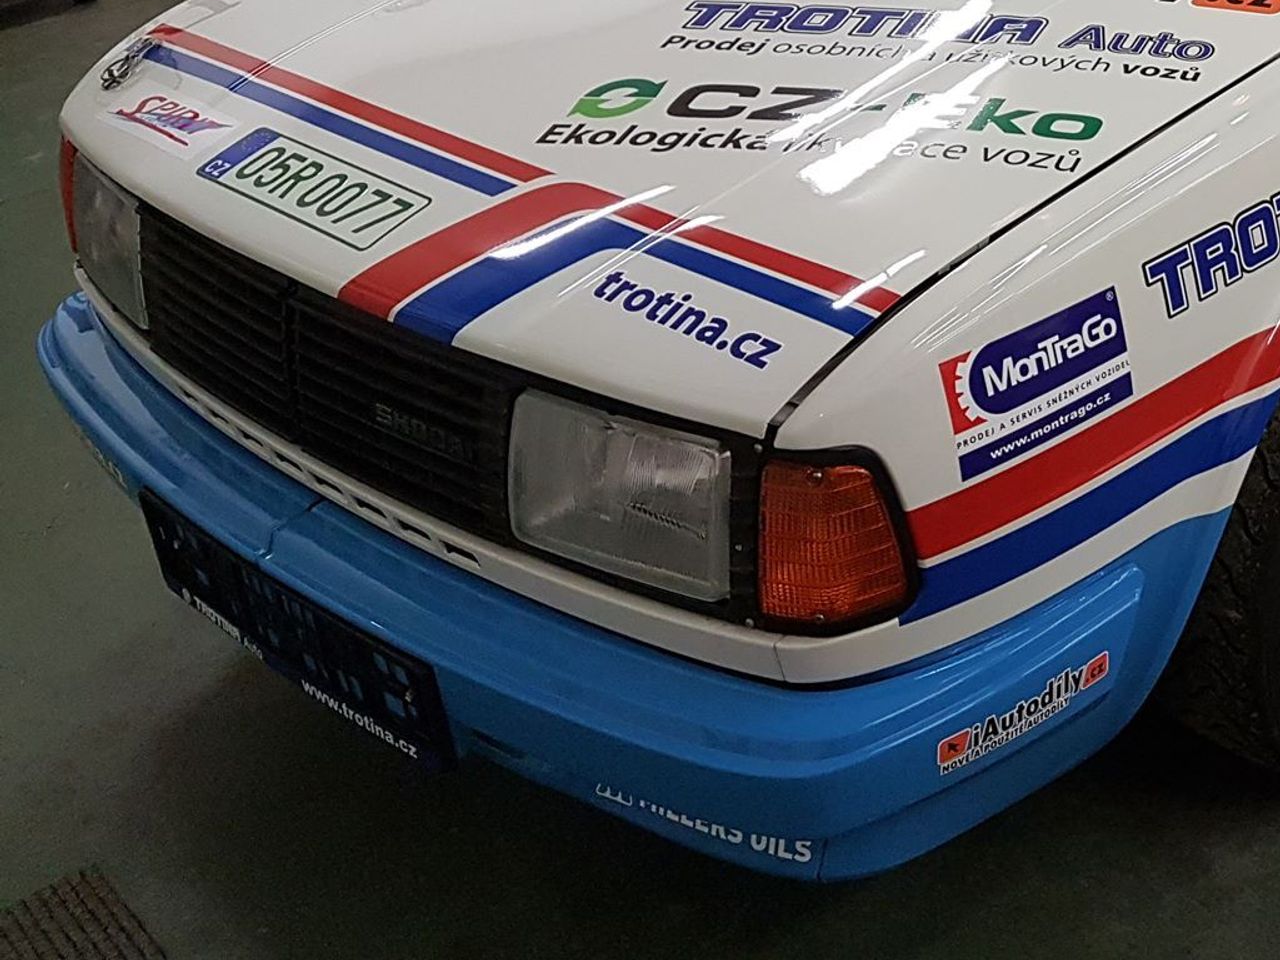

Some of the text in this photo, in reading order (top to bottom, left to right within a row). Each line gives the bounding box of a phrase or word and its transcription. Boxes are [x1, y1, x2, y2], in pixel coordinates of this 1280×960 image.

[660, 35, 770, 55] Prodej
[1121, 65, 1202, 83] vozů
[680, 0, 1216, 63] TROTIA Auto
[666, 83, 1104, 141] CZ-ko
[203, 159, 230, 179] CZ
[536, 123, 768, 153] Ekologická
[981, 148, 1082, 173] vozů
[592, 270, 784, 370] trotina.cz
[981, 313, 1118, 398] MonTraGo
[955, 428, 996, 450] PRODEJ
[999, 422, 1007, 431] A
[1009, 404, 1043, 426] SERVIS
[1095, 360, 1131, 383] VOZIDEL
[989, 392, 1112, 460] www.montrago.cz
[300, 678, 418, 759] www.trotina.cz
[970, 661, 1106, 748] iAutodíly.cz
